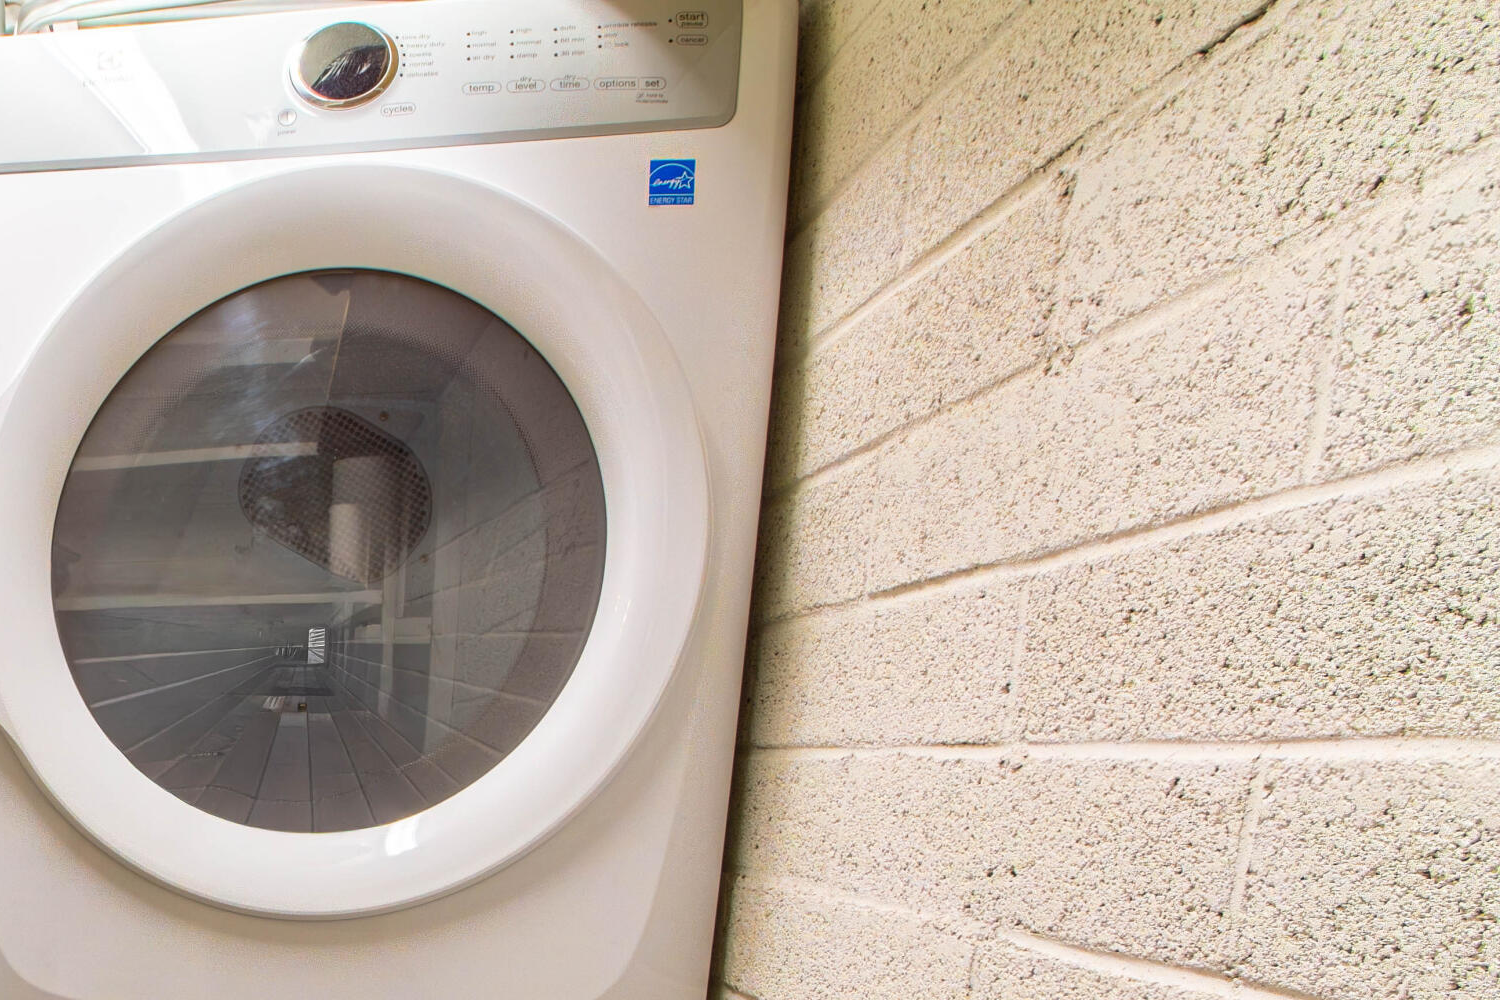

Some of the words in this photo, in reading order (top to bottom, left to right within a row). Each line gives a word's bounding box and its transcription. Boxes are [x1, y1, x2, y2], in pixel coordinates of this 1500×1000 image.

[679, 13, 705, 21] start
[469, 84, 494, 93] temp
[515, 82, 537, 90] level
[559, 81, 581, 89] time
[599, 80, 636, 89] options
[383, 104, 414, 115] cycles
[650, 197, 675, 205] ENERGY
[676, 196, 693, 204] STAR
